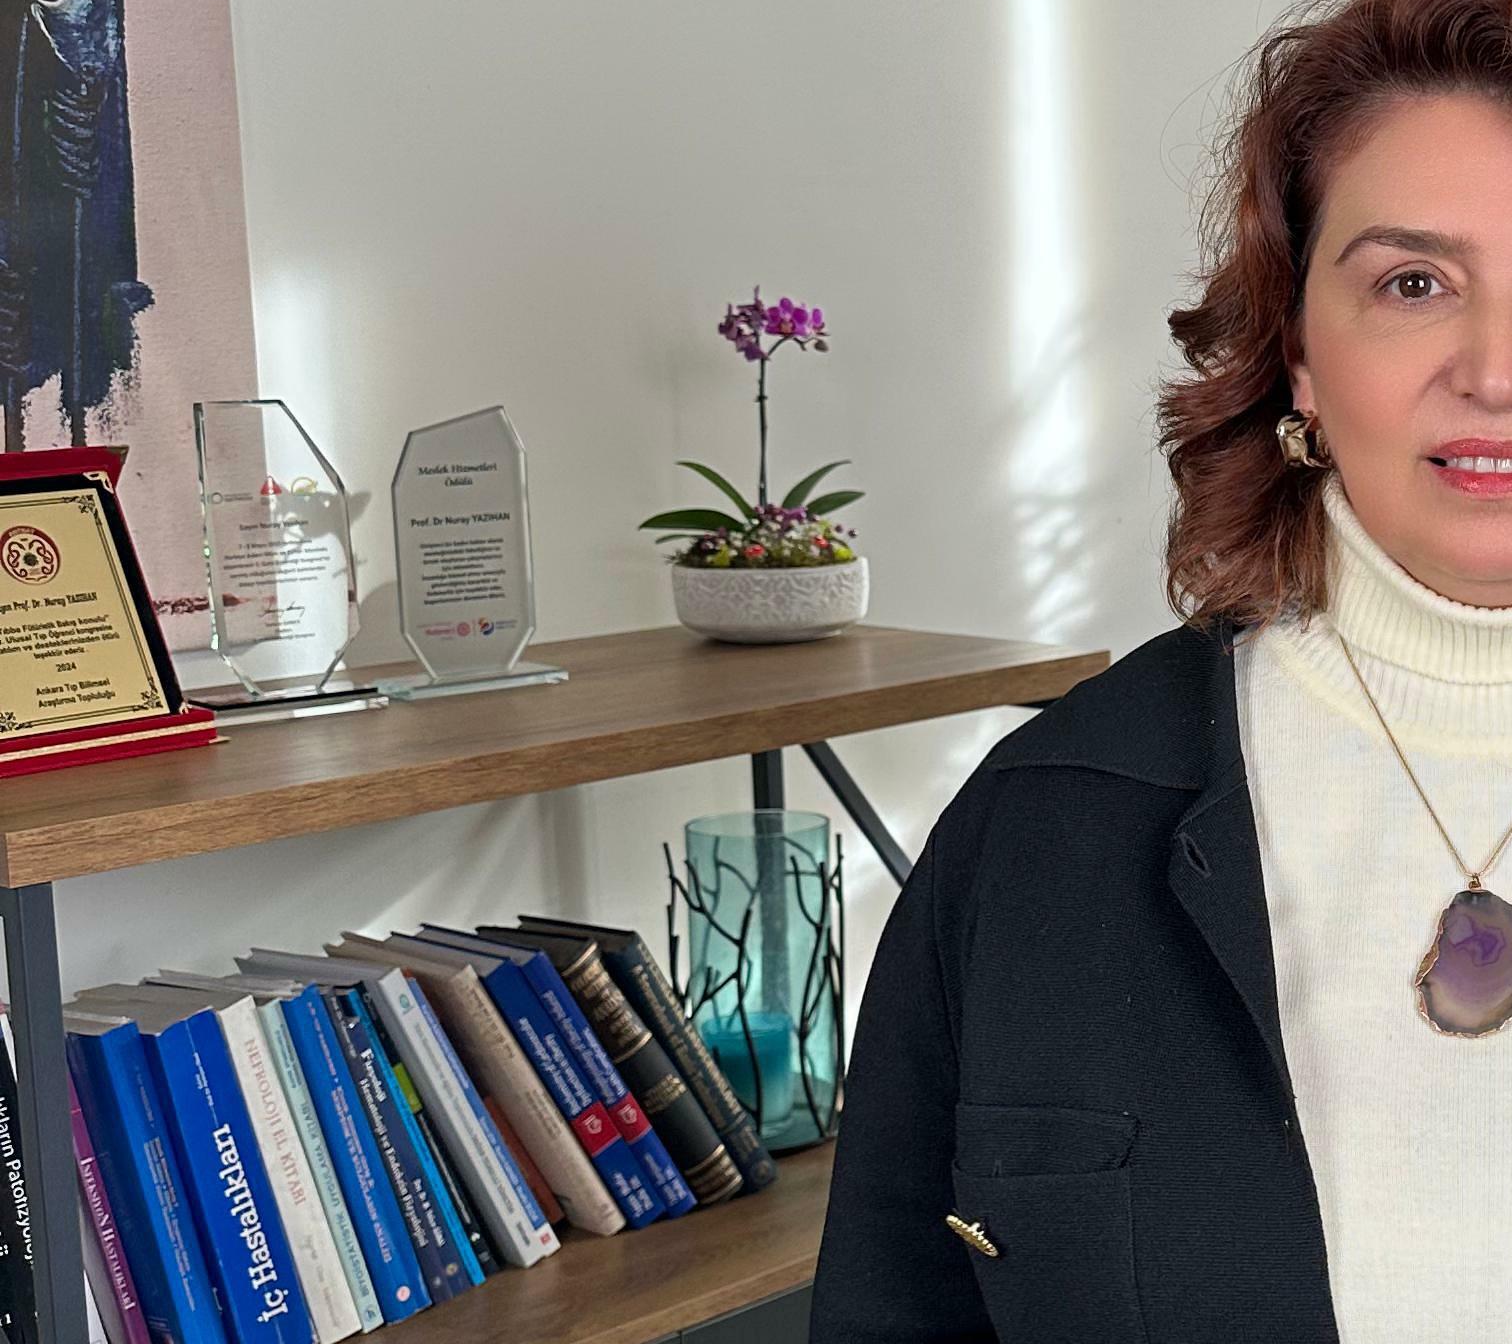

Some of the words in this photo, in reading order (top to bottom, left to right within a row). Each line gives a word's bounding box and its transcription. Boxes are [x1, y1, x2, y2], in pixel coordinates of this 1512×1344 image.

[55, 661, 77, 673] 2024
[36, 684, 64, 696] Ankara
[270, 1127, 290, 1152] EL
[201, 1122, 277, 1291] Hastalıkları
[247, 1287, 292, 1325] İç
